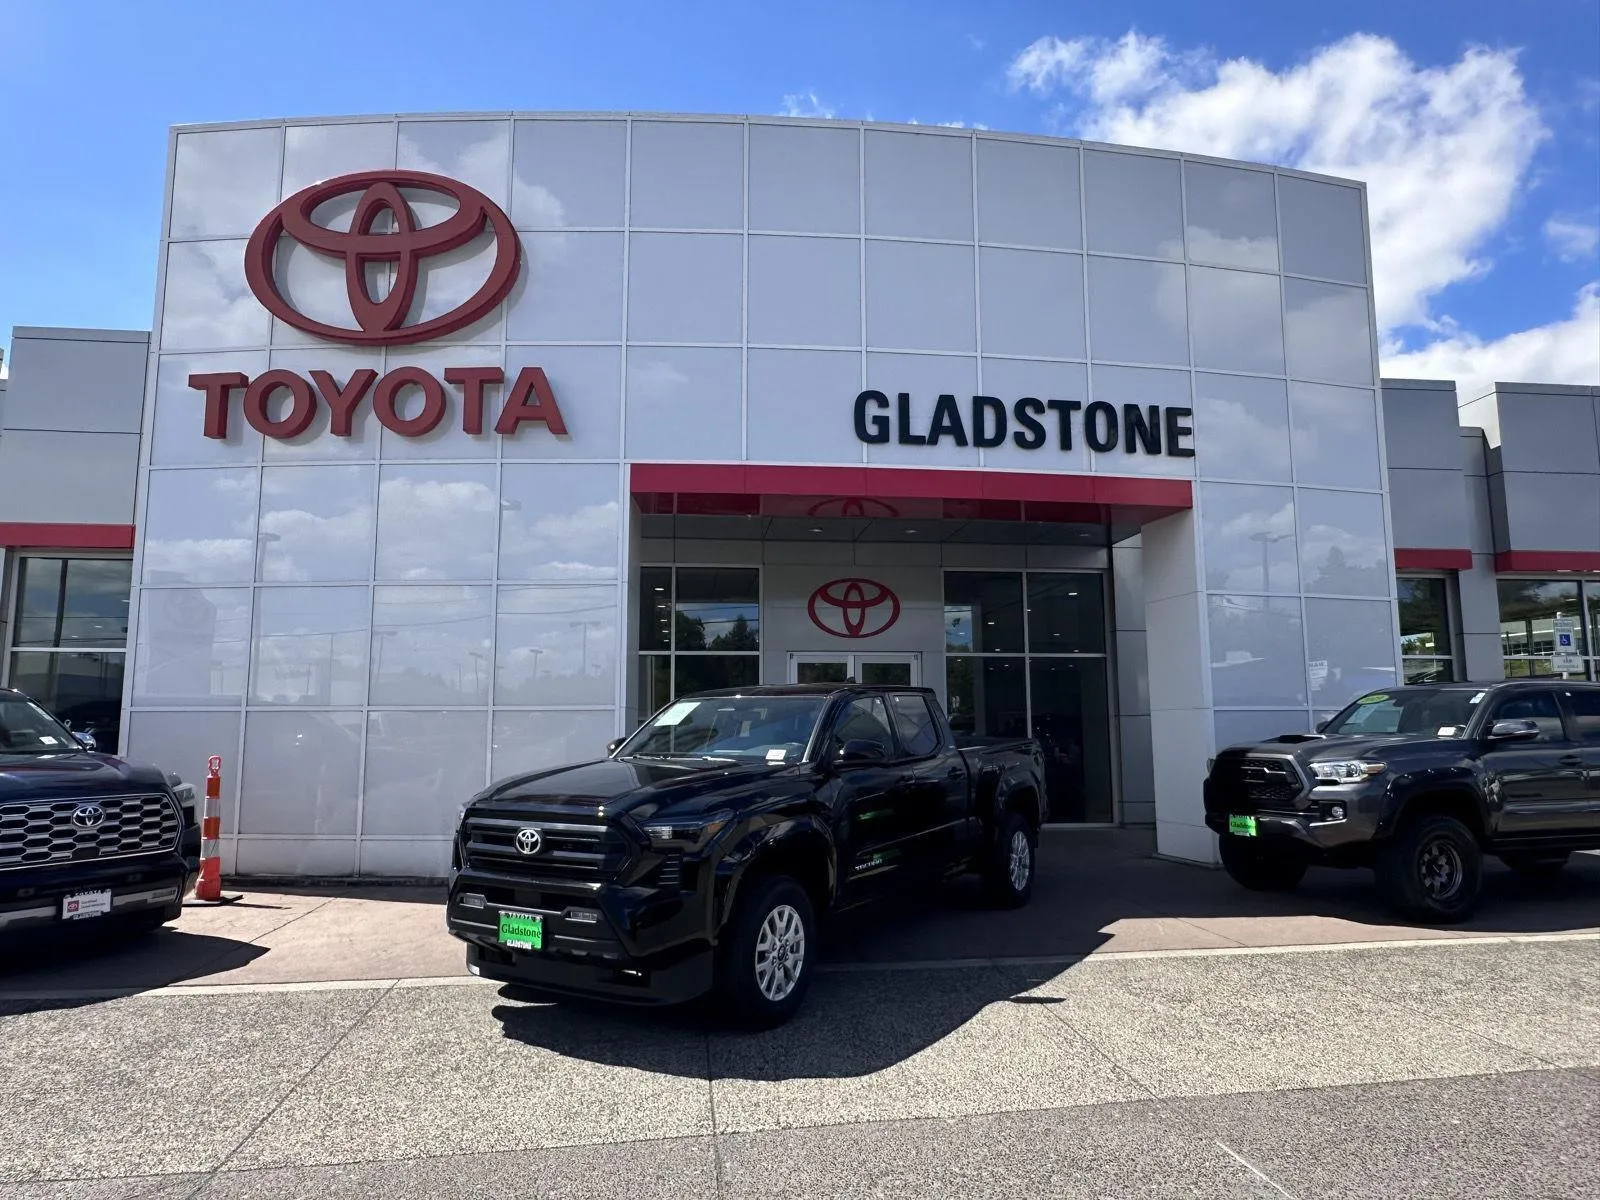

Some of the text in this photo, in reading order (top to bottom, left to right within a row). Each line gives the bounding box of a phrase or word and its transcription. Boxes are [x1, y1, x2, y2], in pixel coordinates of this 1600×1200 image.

[188, 366, 568, 440] TOYOTA
[853, 389, 1195, 457] GLADSTONE
[501, 923, 542, 938] Gladstone
